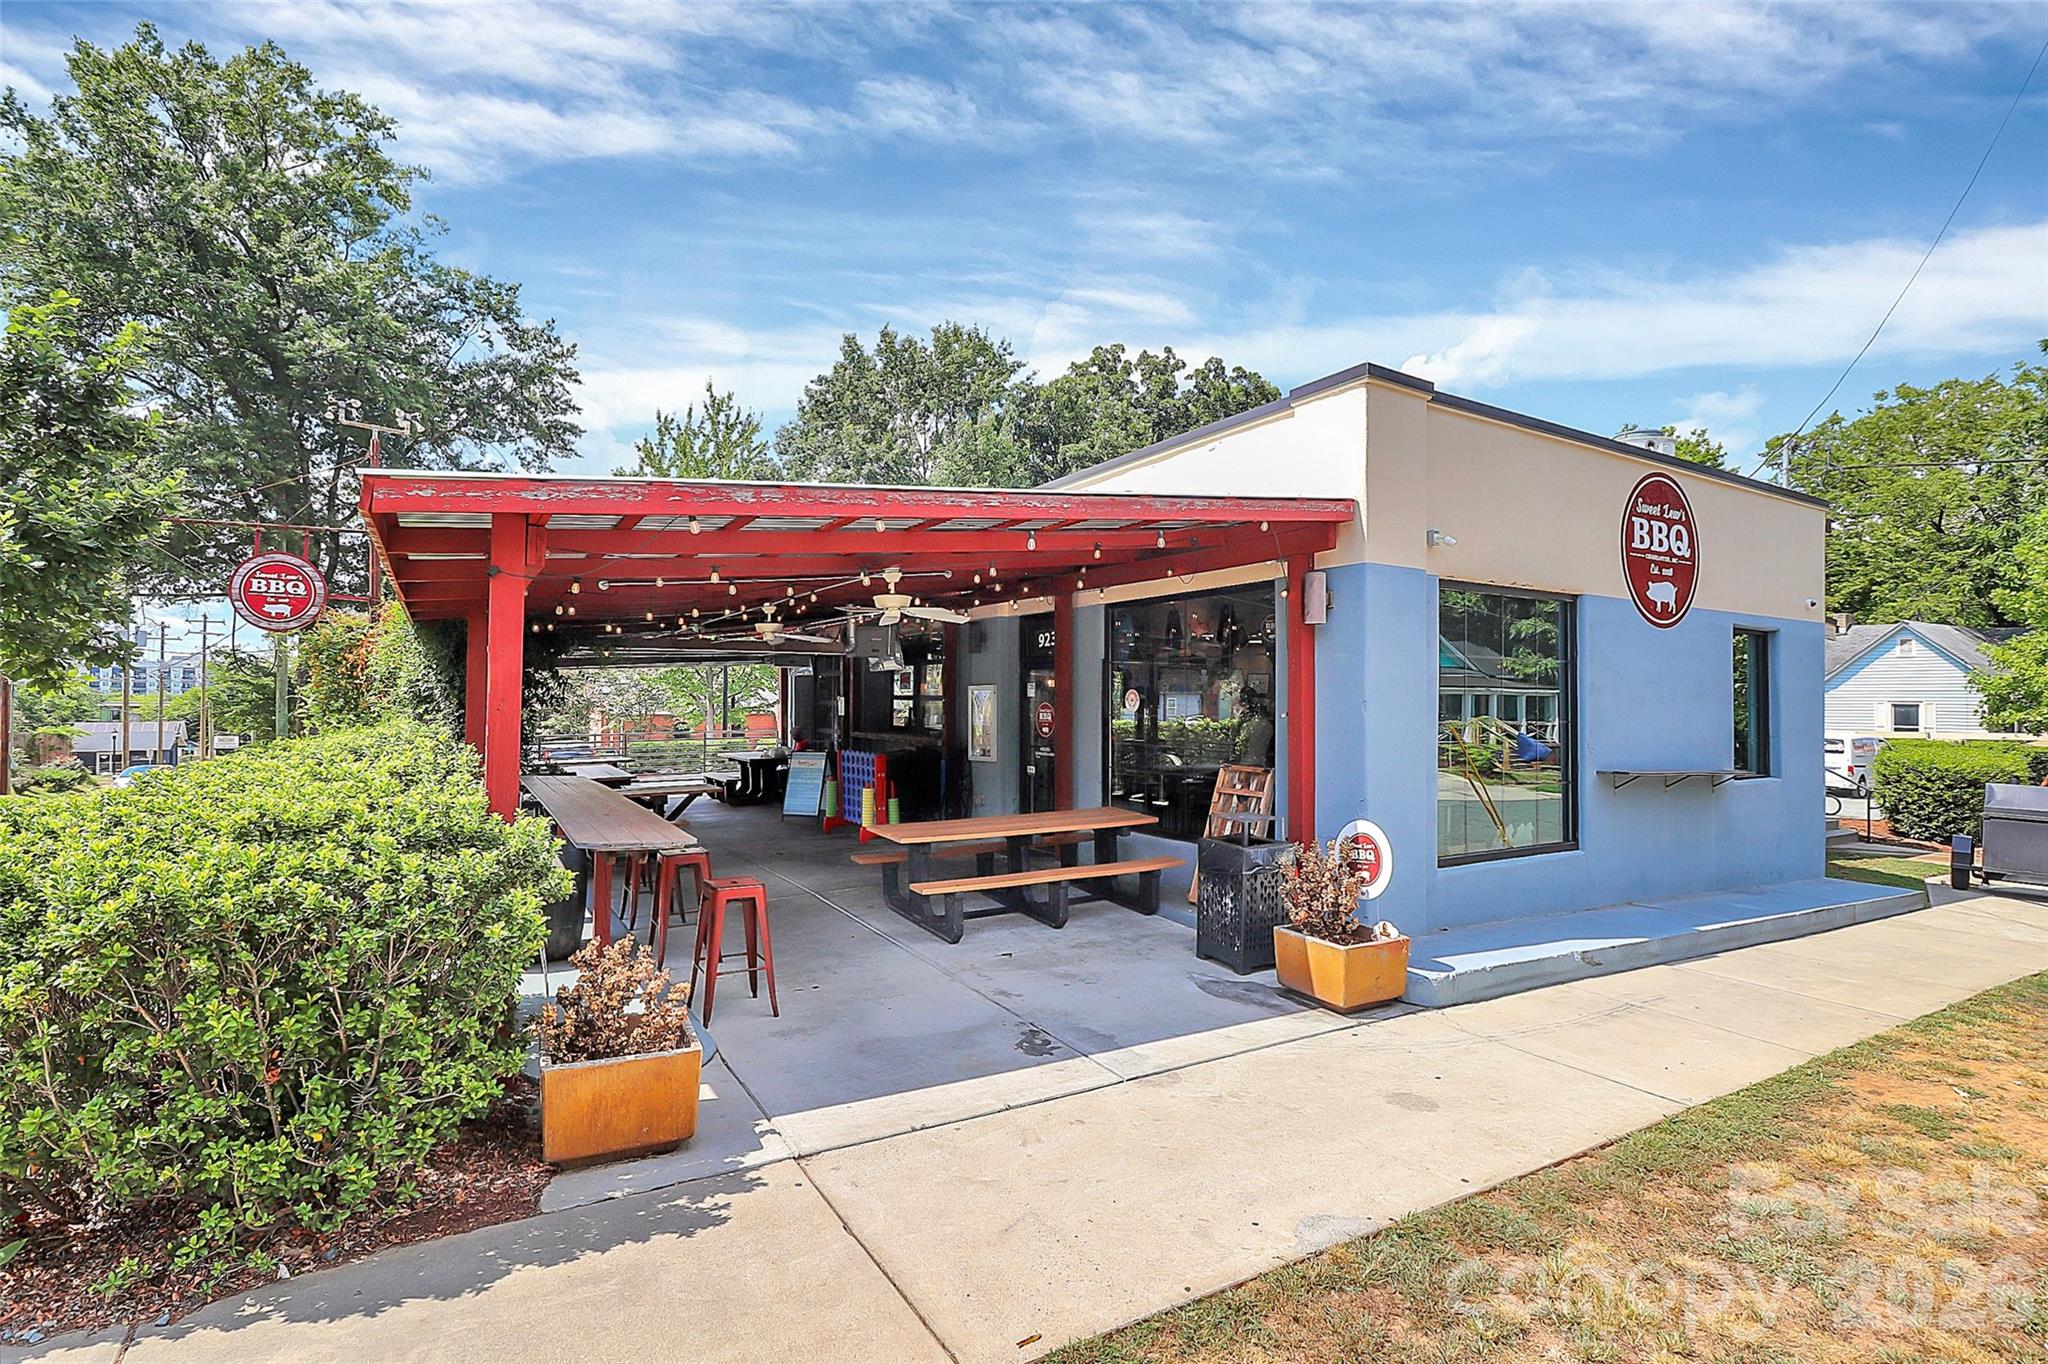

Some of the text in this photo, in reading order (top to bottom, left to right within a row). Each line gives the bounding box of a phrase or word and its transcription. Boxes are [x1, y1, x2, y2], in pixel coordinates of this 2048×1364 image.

[1636, 497, 1661, 516] Sweet
[1631, 516, 1691, 558] BBQ
[249, 578, 308, 596] BBQ
[1352, 849, 1376, 862] BBQ
